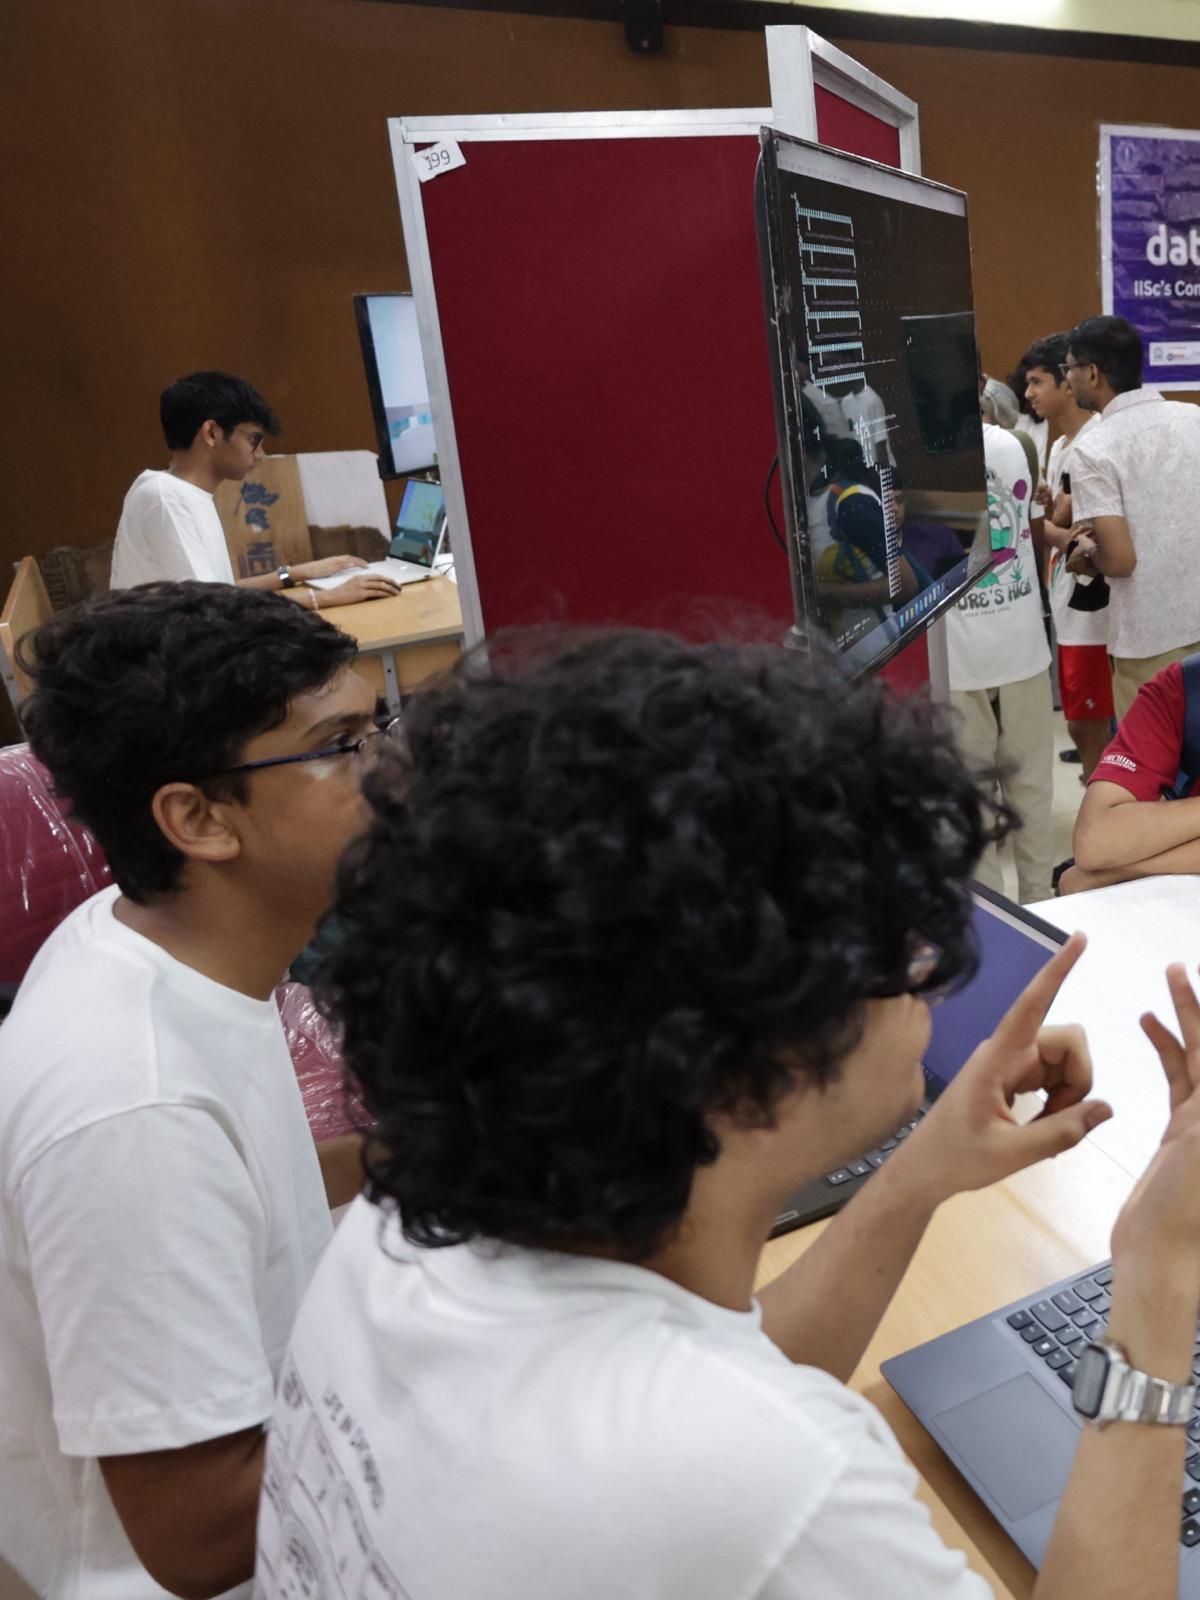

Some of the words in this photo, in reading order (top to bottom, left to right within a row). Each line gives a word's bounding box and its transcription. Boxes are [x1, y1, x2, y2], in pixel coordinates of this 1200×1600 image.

[424, 150, 450, 170] 199
[1134, 280, 1172, 296] IISc's
[955, 588, 1005, 611] URE'S
